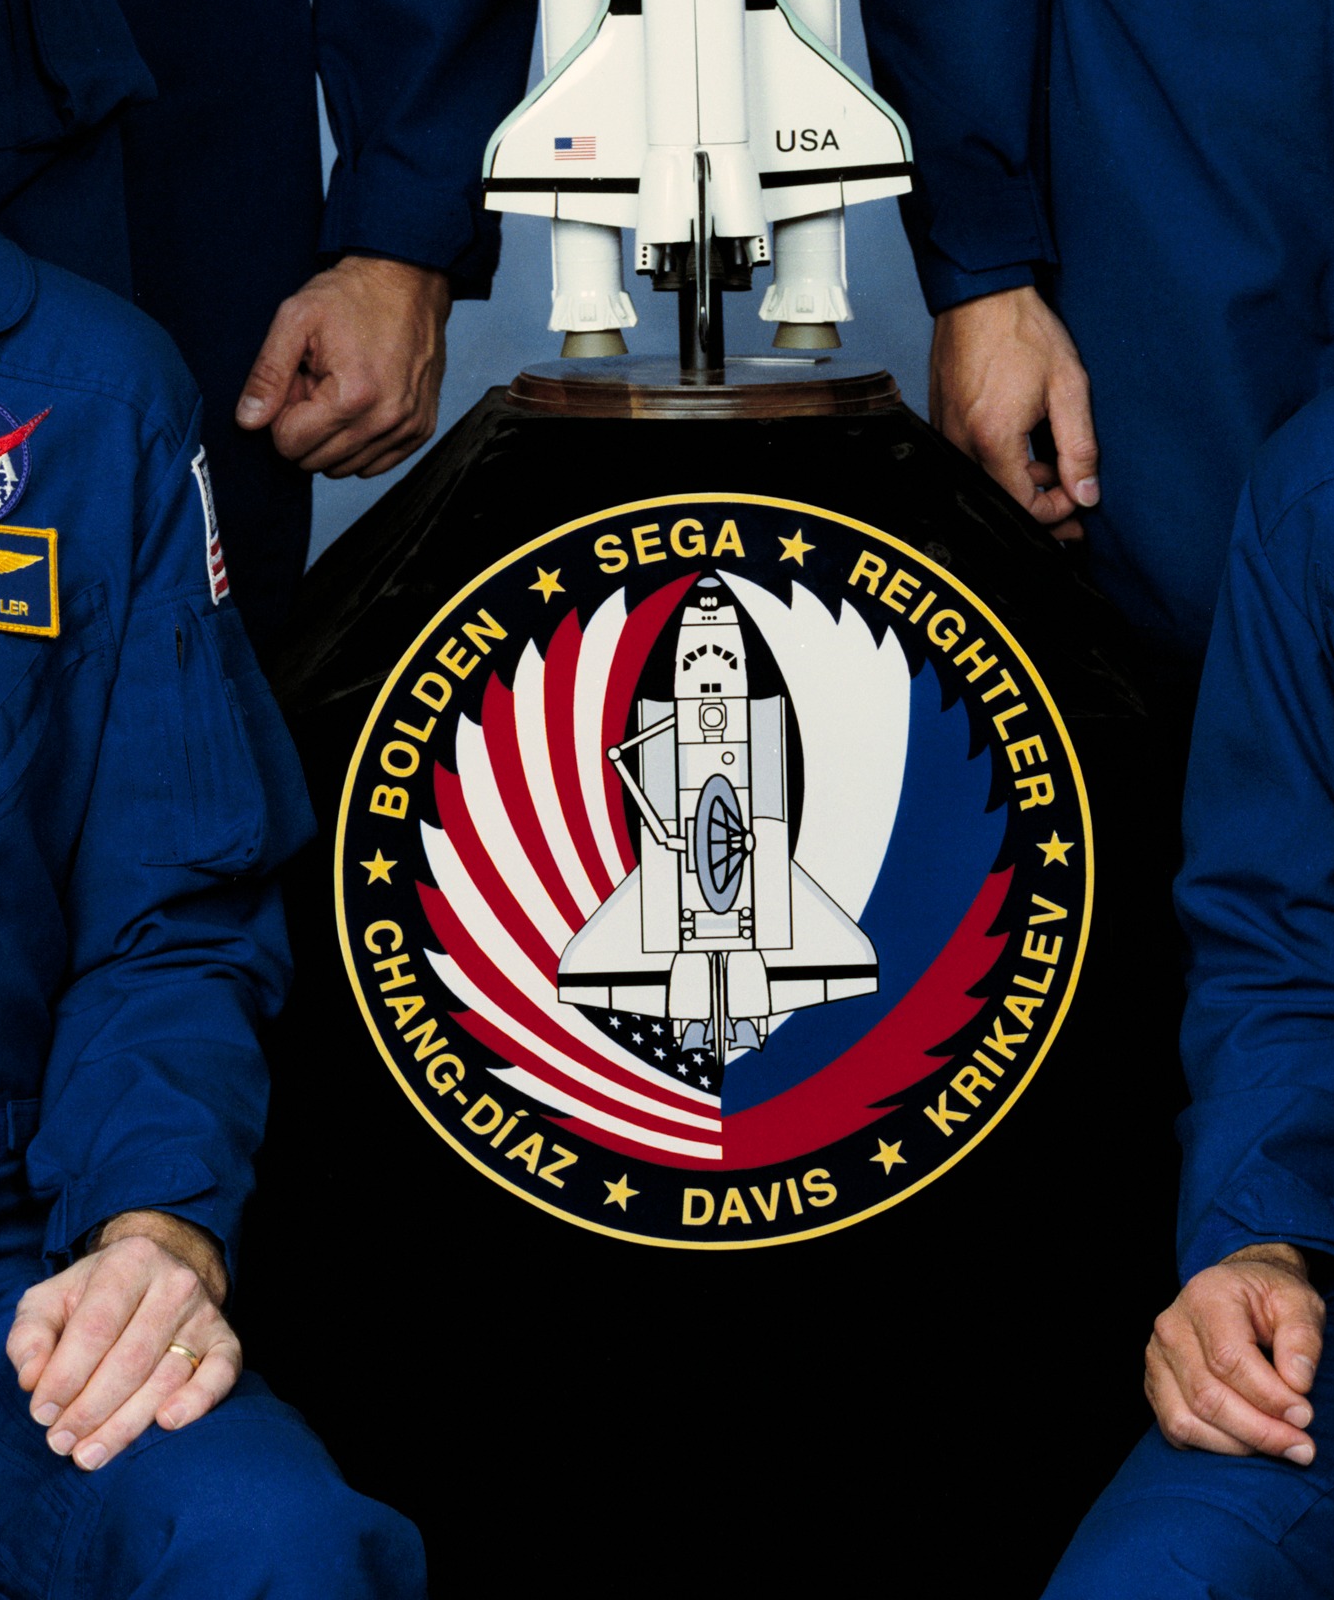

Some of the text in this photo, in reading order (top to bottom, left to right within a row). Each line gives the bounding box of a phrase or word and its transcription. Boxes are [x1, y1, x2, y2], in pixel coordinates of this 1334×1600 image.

[776, 129, 839, 152] USA
[369, 518, 1056, 819] BOLDEN SEGA REIGHTLER
[364, 893, 1068, 1226] CHANG-DÍAZ DAVIS KRIKALEV
